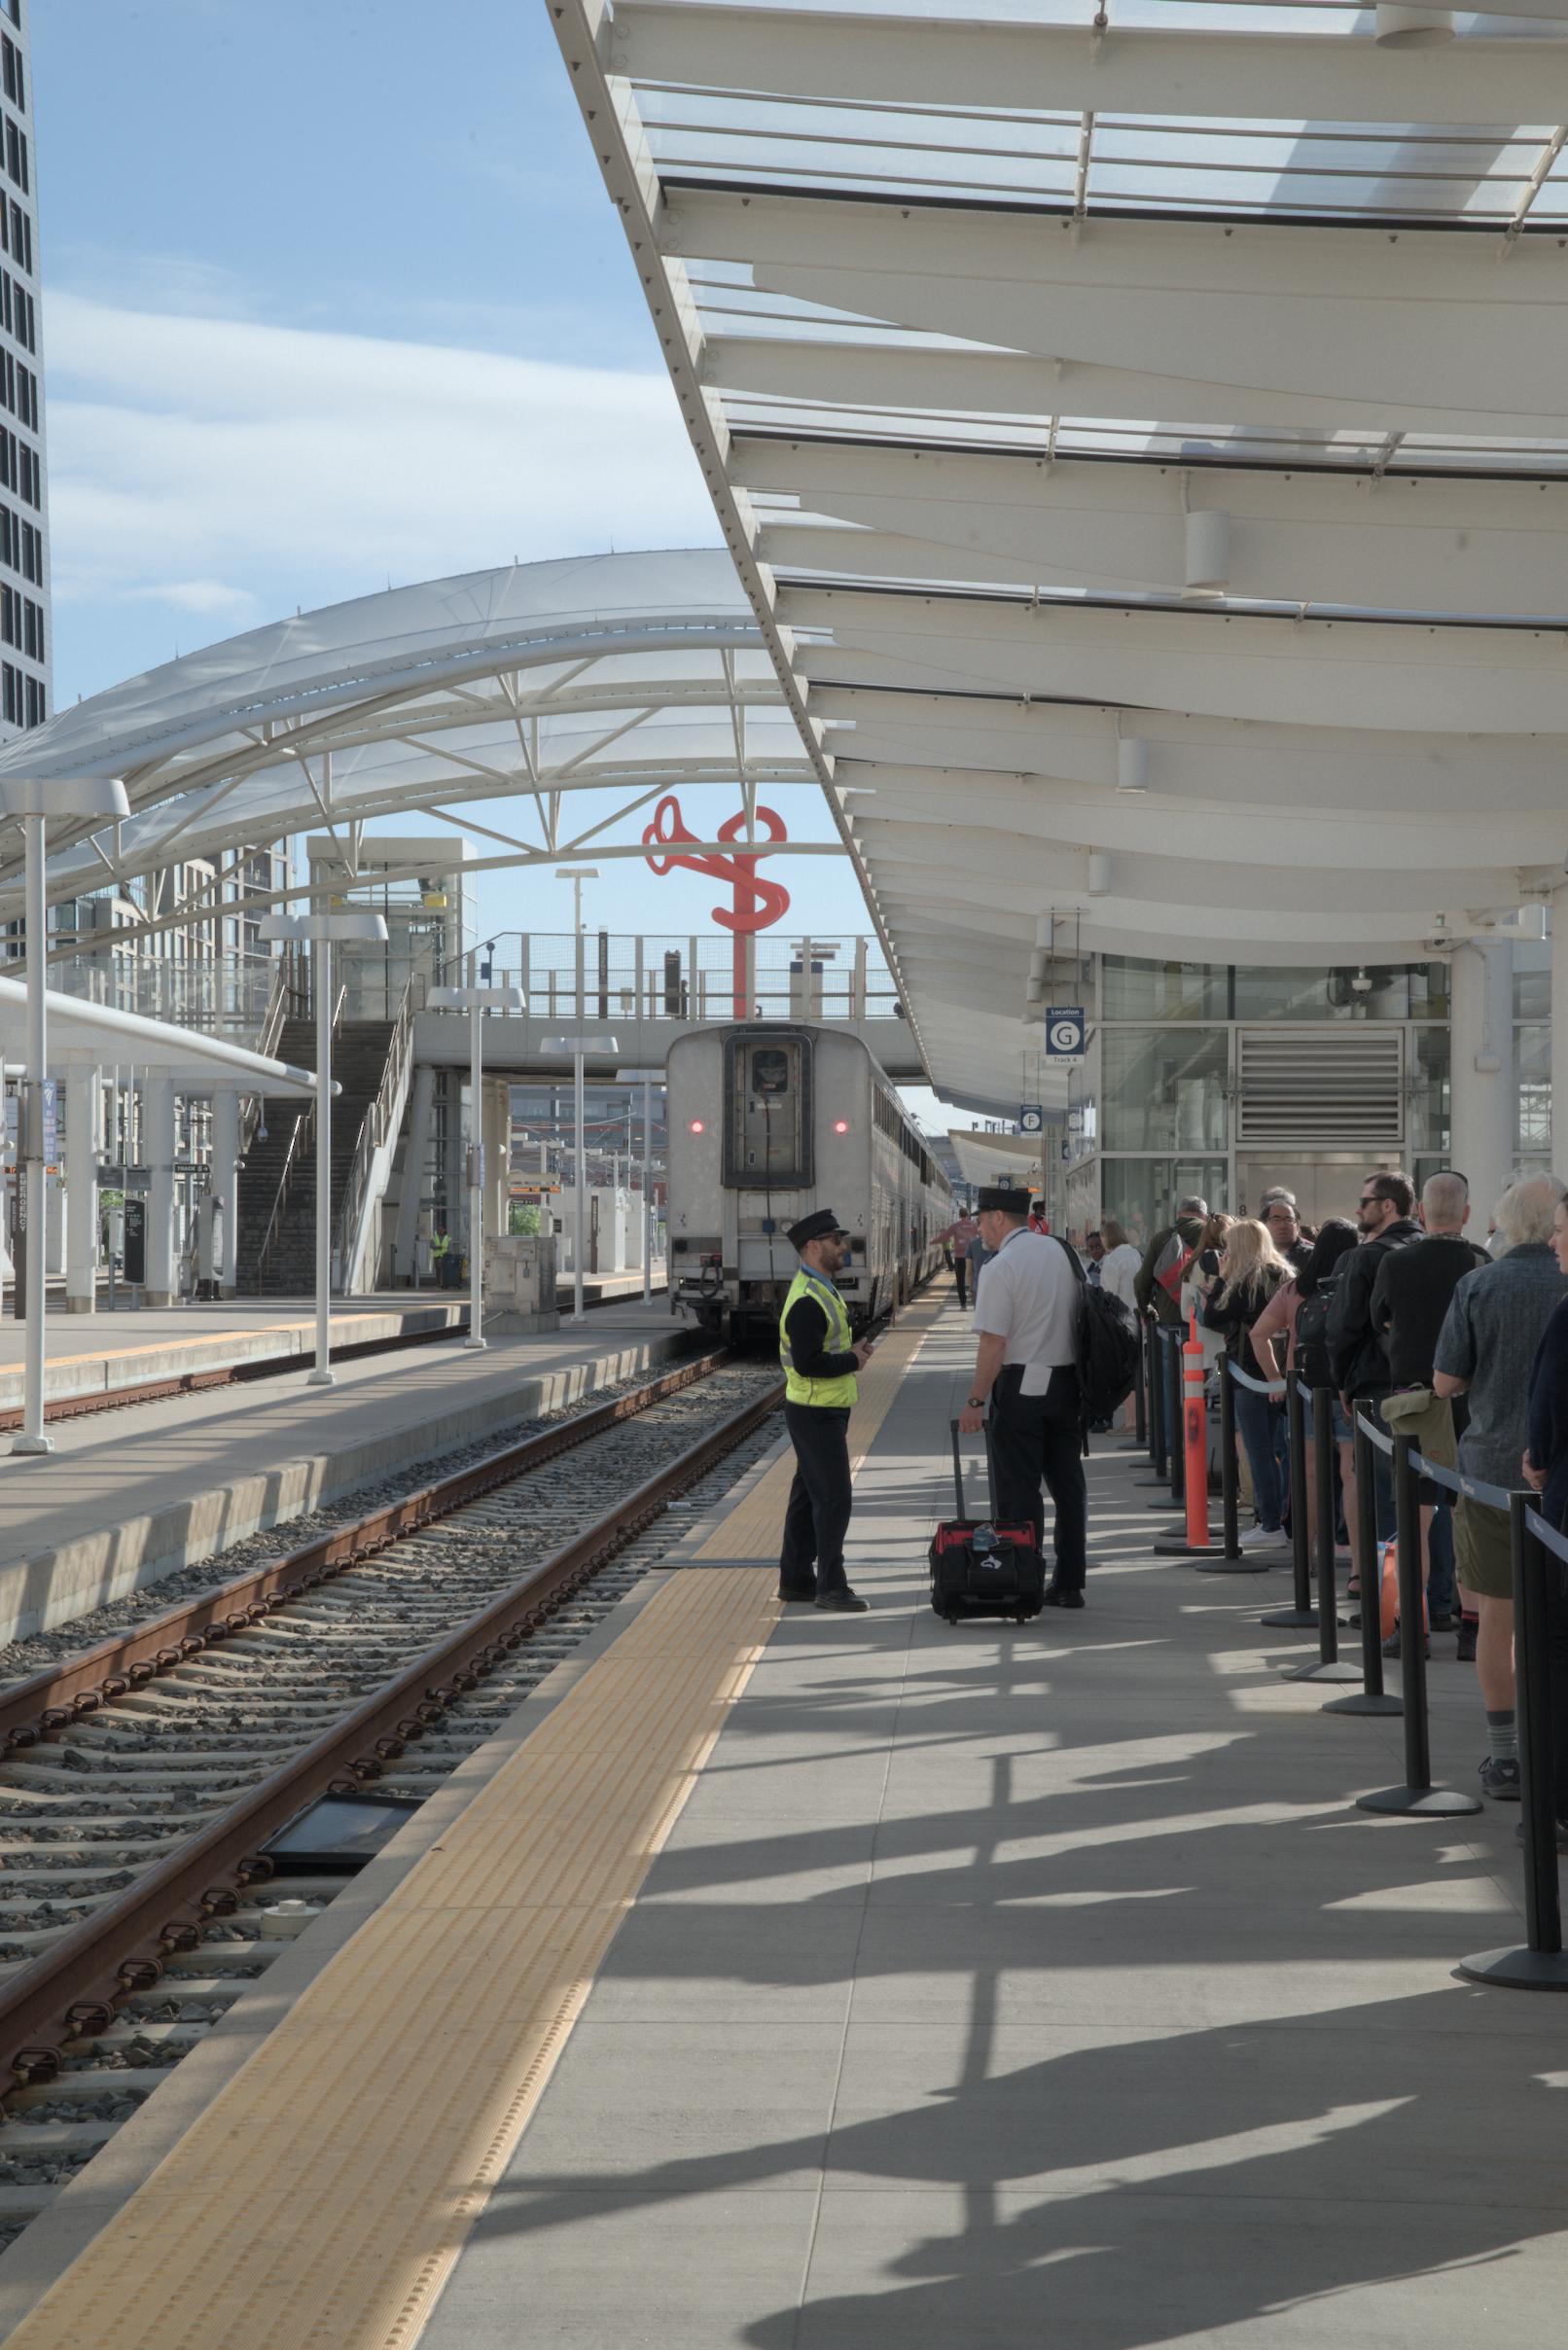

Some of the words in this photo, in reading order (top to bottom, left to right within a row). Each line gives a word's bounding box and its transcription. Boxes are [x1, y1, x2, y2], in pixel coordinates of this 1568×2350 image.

[1056, 1026, 1072, 1045] G
[1028, 1116, 1035, 1126] F
[1239, 1204, 1247, 1217] 8
